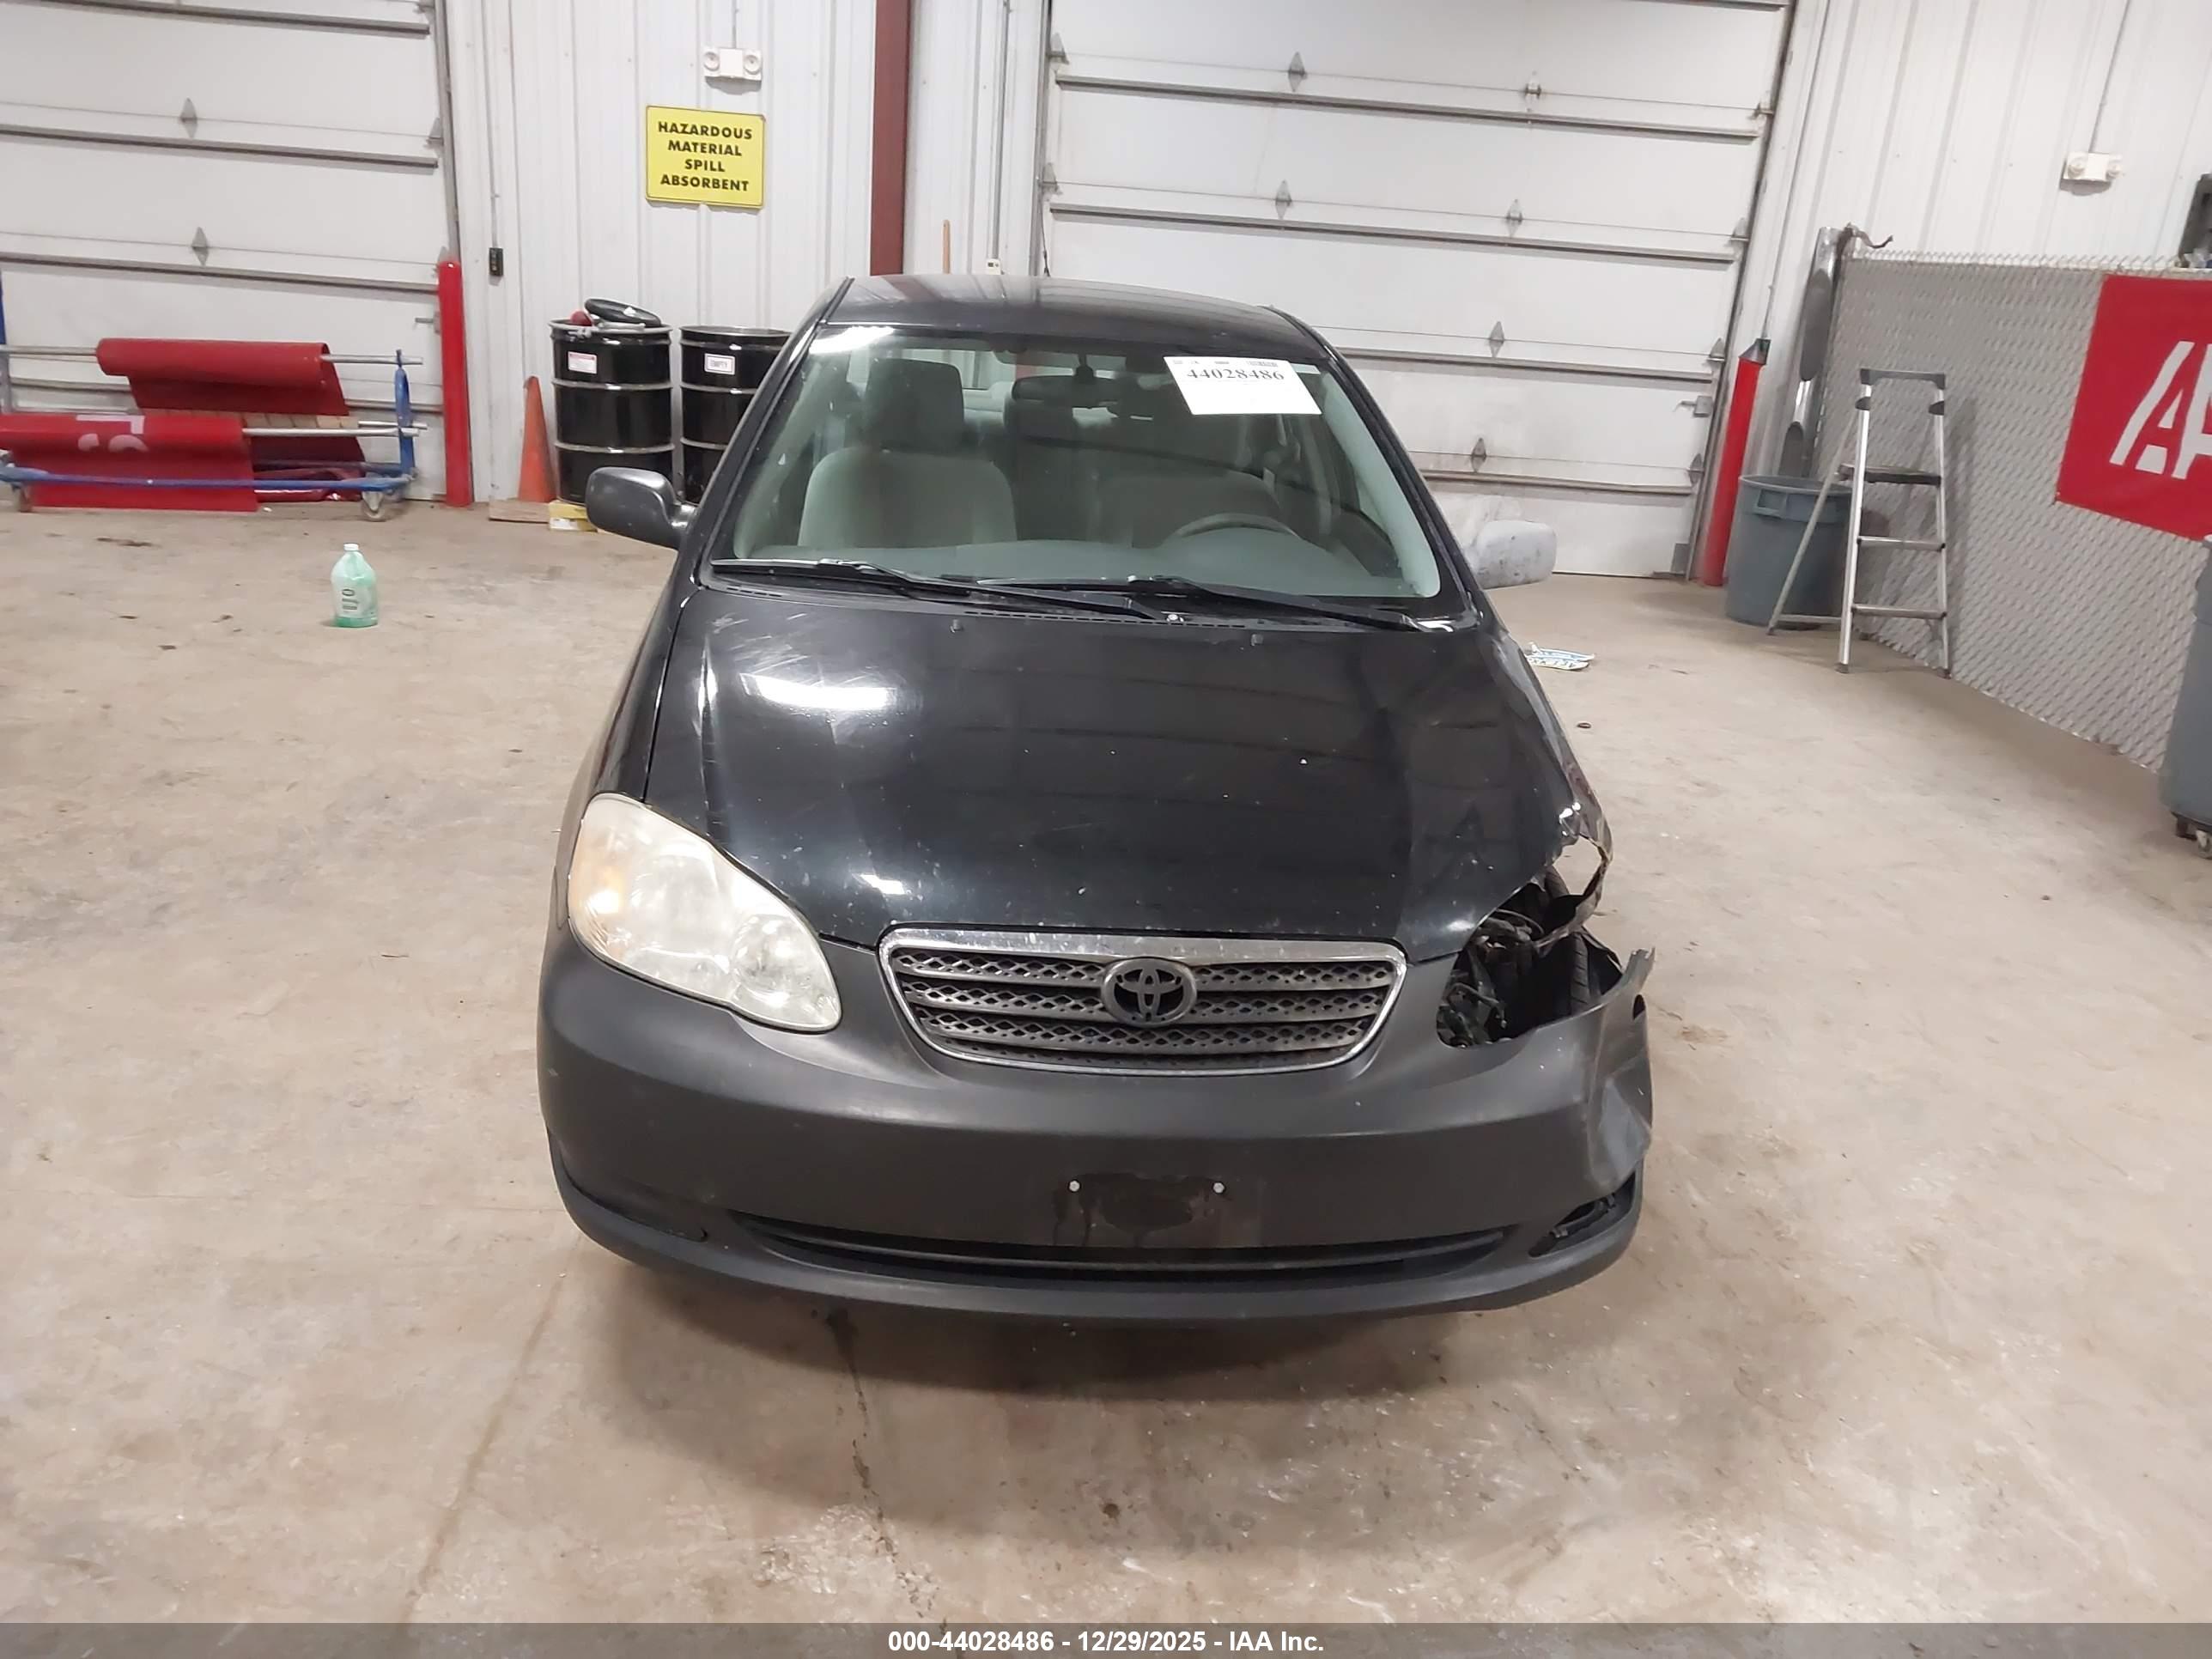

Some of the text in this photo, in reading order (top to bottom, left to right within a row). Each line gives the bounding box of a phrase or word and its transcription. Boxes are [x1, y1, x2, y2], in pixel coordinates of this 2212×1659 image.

[658, 121, 752, 139] HAZARDOUS
[668, 140, 742, 156] MATERIAL
[684, 159, 726, 172] SPILL
[660, 174, 749, 191] ABSORBENT
[1187, 368, 1285, 380] 44028486
